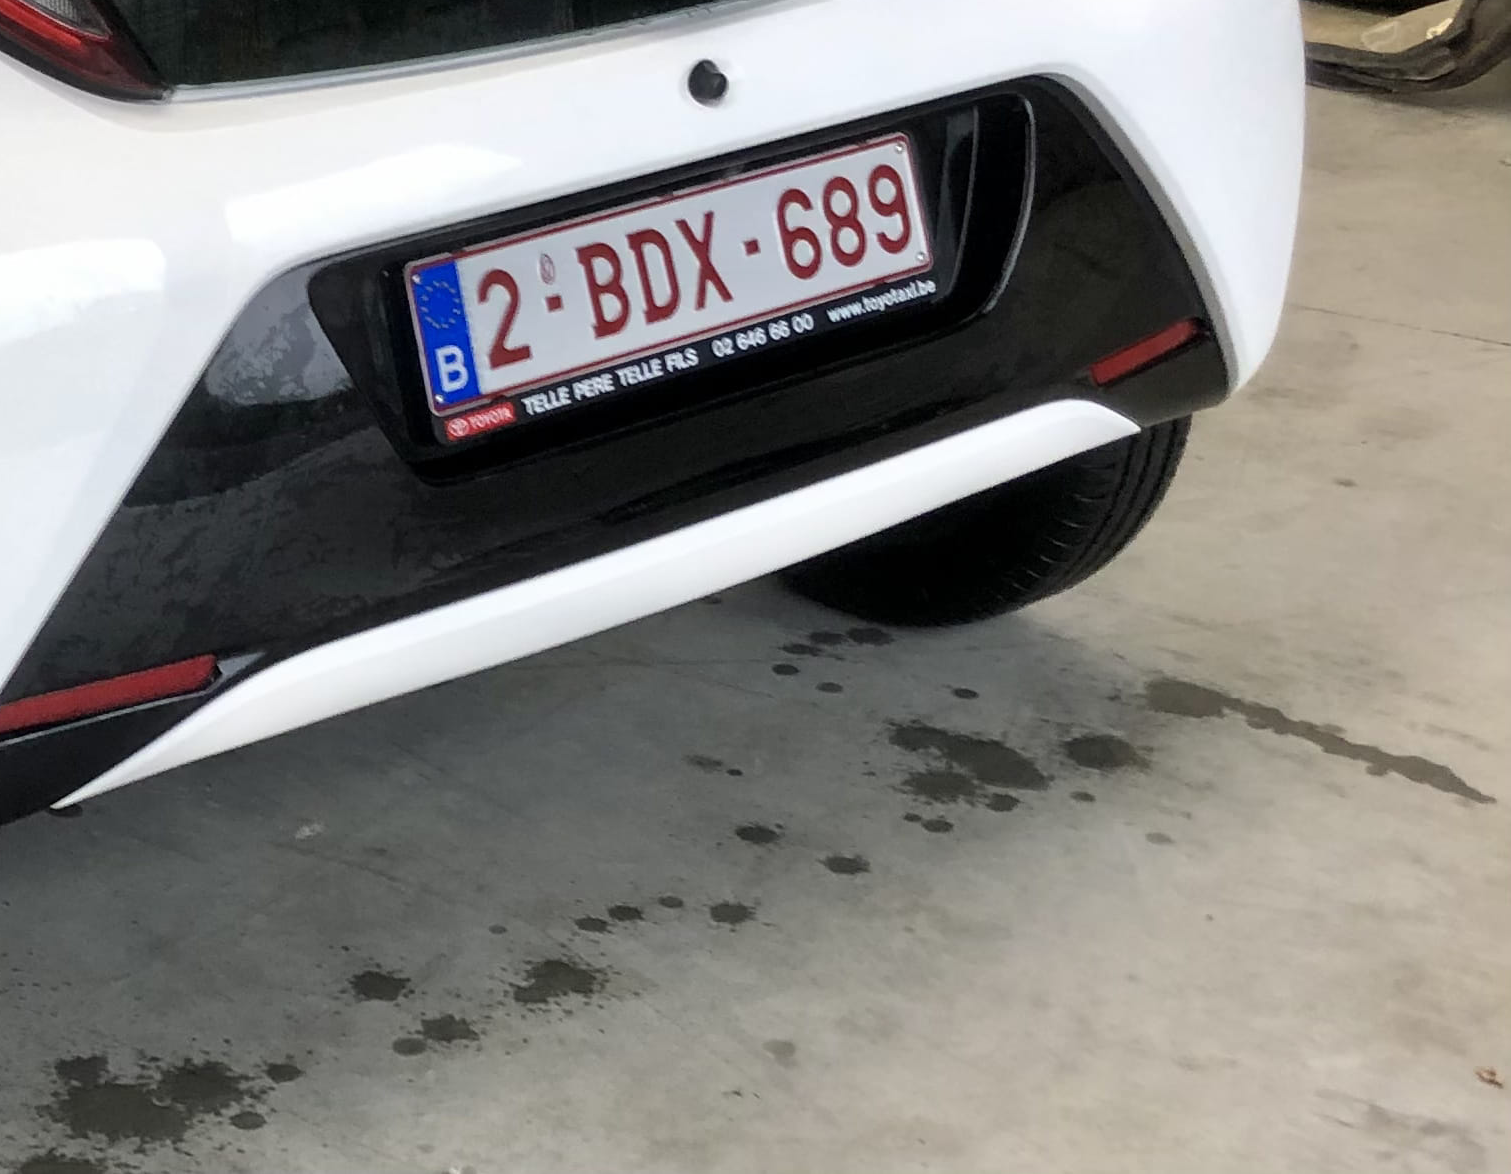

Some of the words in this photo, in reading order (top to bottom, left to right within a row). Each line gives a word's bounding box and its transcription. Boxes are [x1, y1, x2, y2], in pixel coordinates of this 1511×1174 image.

[435, 344, 469, 393] B
[520, 385, 572, 416] TELLE
[616, 358, 663, 386] TELLE
[664, 348, 699, 372] FILS
[711, 337, 735, 358] 02
[735, 327, 768, 350] 646
[768, 320, 790, 341] 66
[791, 313, 814, 334] 00
[468, 407, 513, 429] TOYOTA
